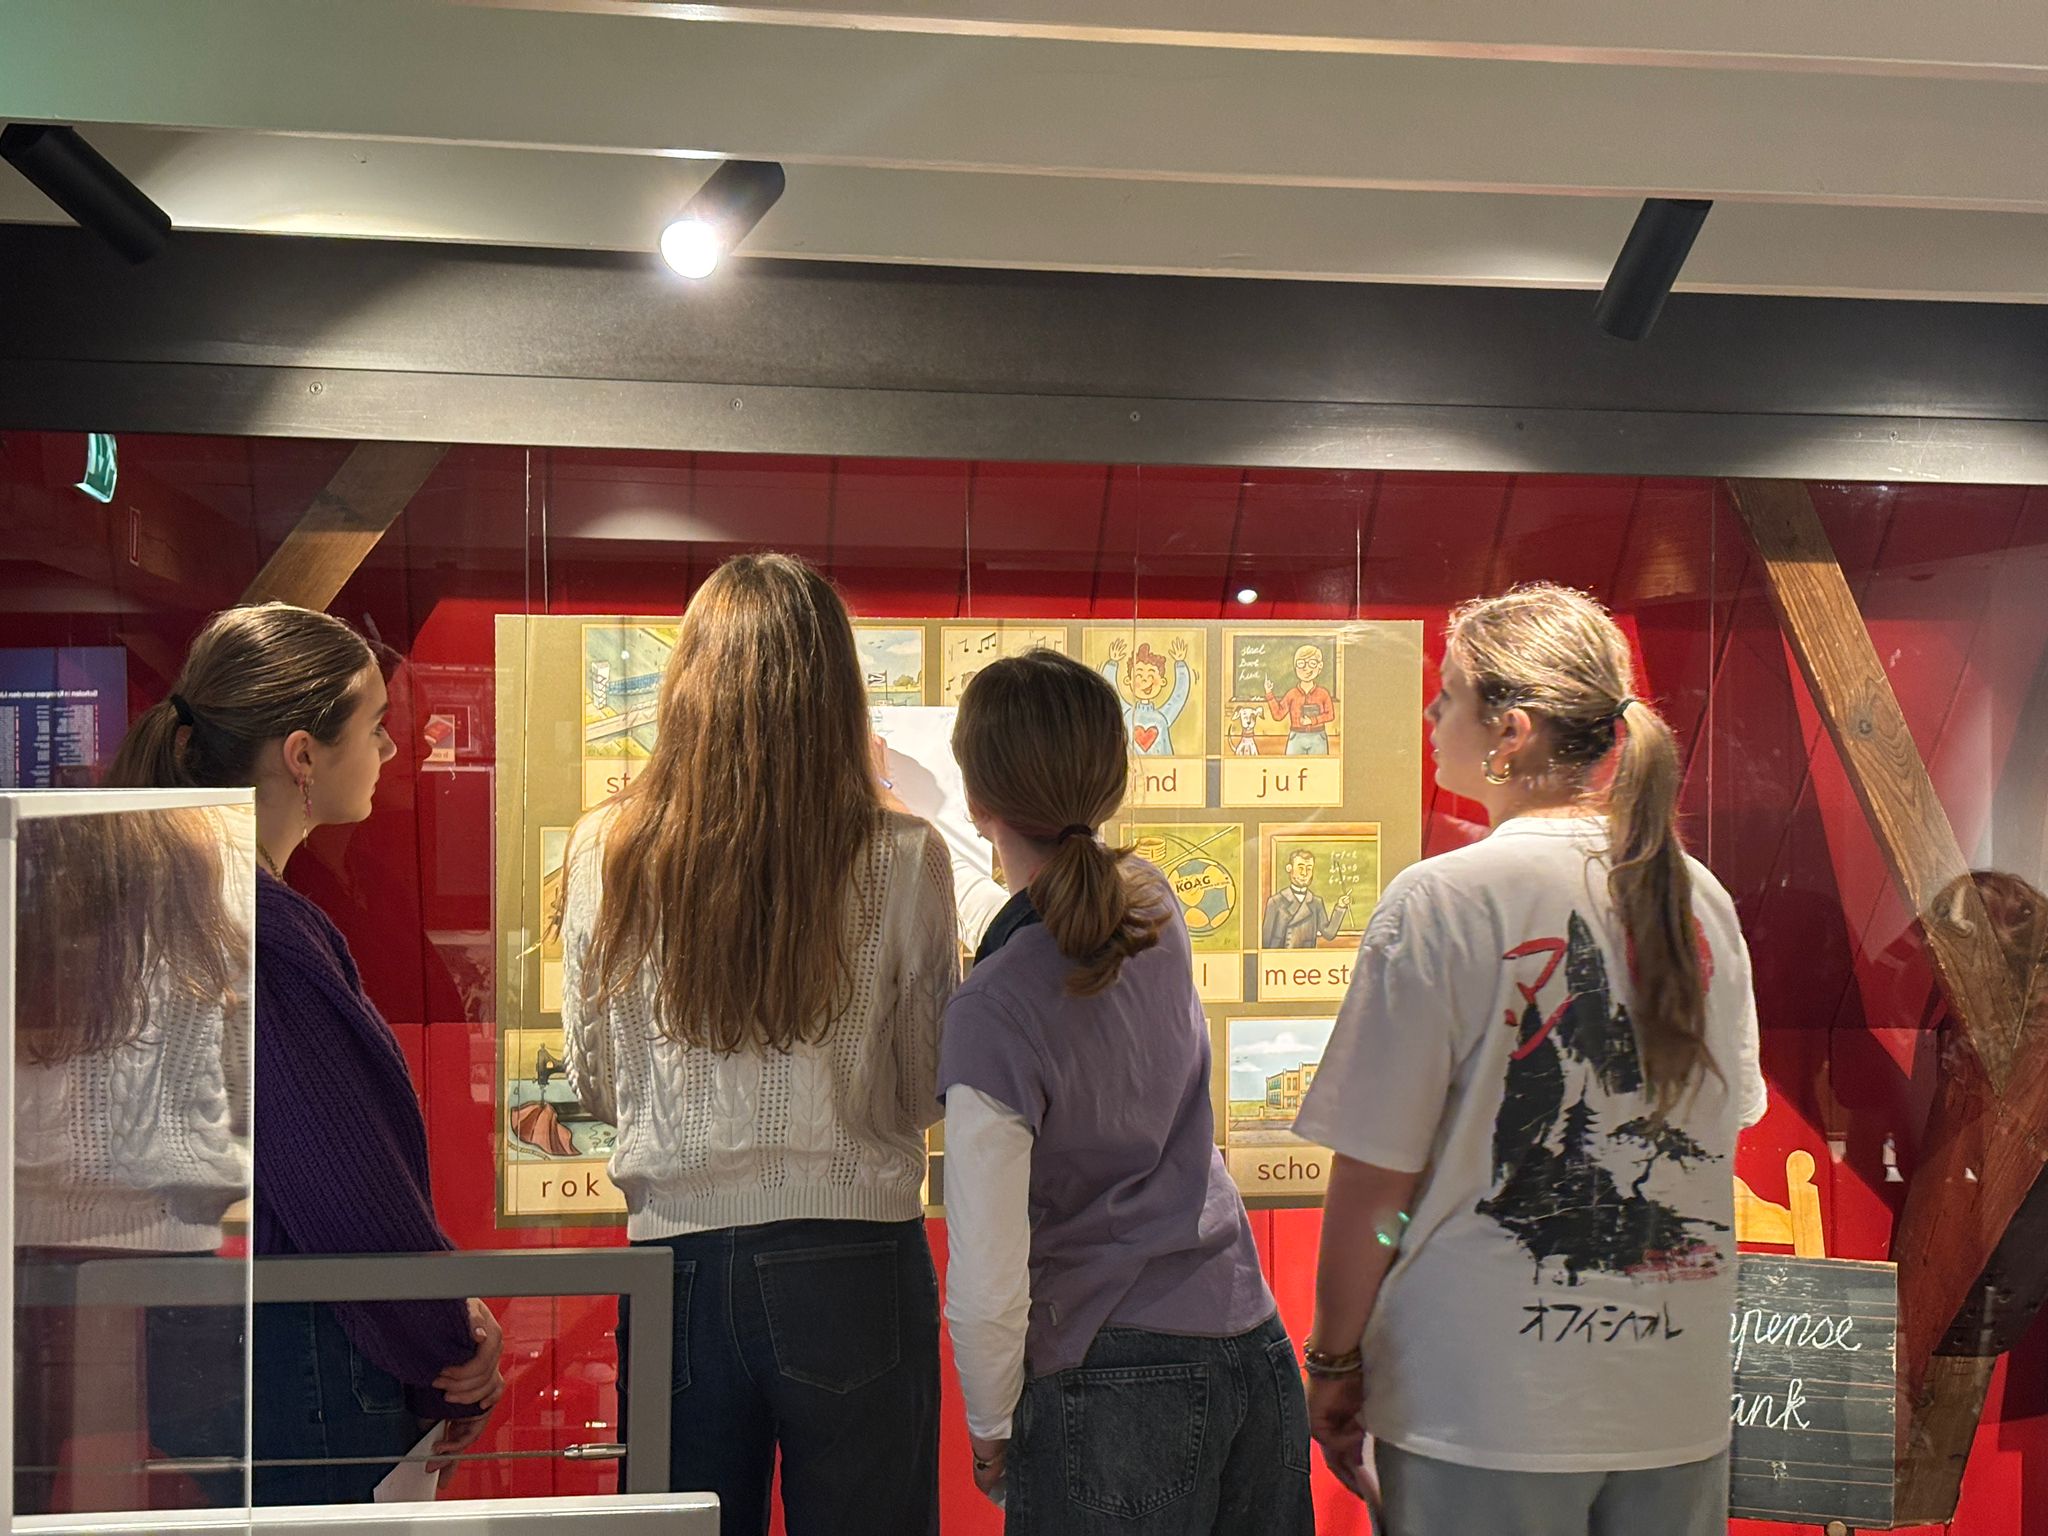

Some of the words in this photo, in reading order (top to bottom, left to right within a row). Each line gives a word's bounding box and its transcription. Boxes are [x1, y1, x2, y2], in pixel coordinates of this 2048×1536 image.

[606, 772, 632, 794] st
[1132, 767, 1177, 792] ind
[1256, 767, 1309, 798] juf
[1175, 875, 1211, 894] KOAG
[1264, 963, 1354, 986] meest
[1257, 1155, 1321, 1181] scho
[541, 1171, 601, 1198] rok
[1730, 1378, 1811, 1431] ank
